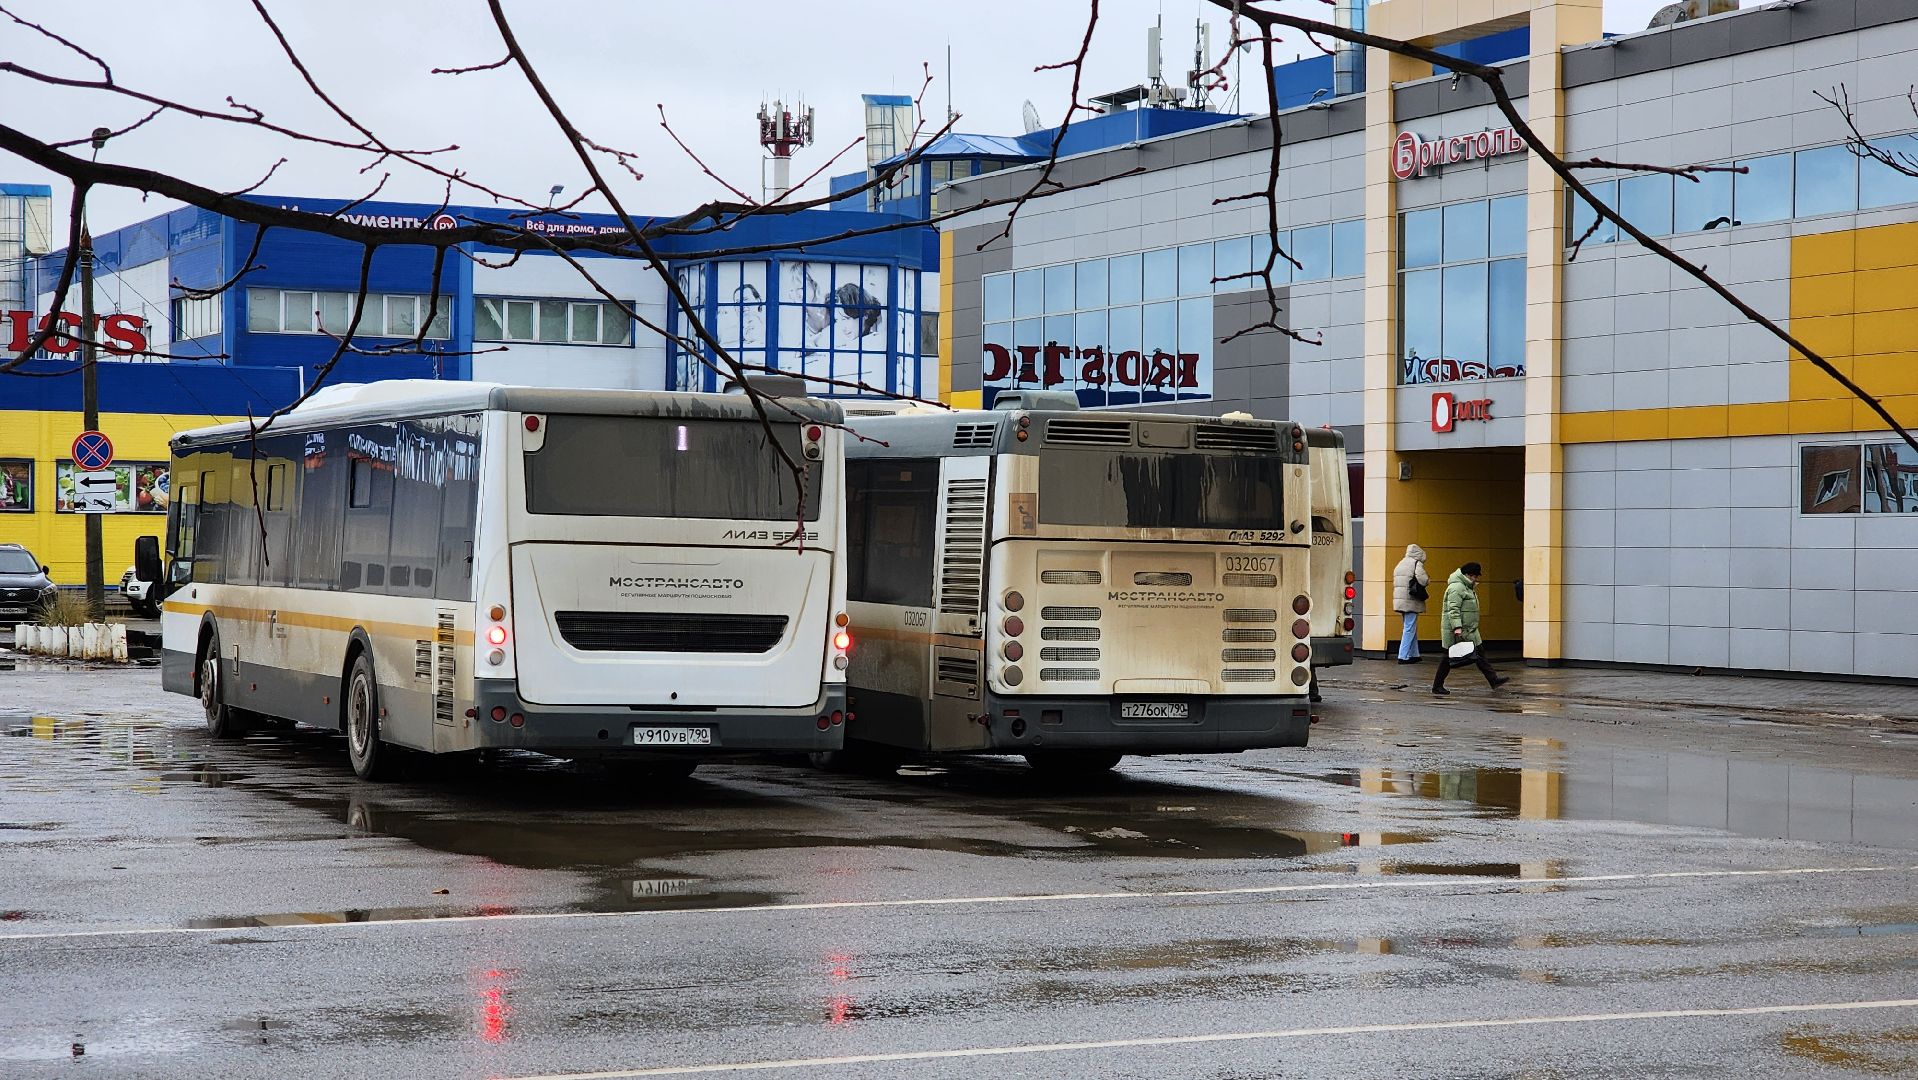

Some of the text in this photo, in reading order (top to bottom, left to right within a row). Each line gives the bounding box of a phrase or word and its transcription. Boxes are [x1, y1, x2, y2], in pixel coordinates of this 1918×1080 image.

[1392, 129, 1523, 179] Бристоль
[526, 220, 545, 231] Всё
[547, 224, 565, 233] для
[567, 224, 597, 235] дома,
[1457, 399, 1493, 421] МТС
[1260, 532, 1285, 541] 5292
[1226, 556, 1276, 572] 032067
[609, 577, 744, 589] МОСТРАНСАВТО
[1108, 591, 1225, 602] МОСТРАНСАВТО
[904, 611, 927, 627] 032067
[1125, 703, 1185, 717] Т276ОК 790
[638, 728, 708, 743] У910УВ 790
